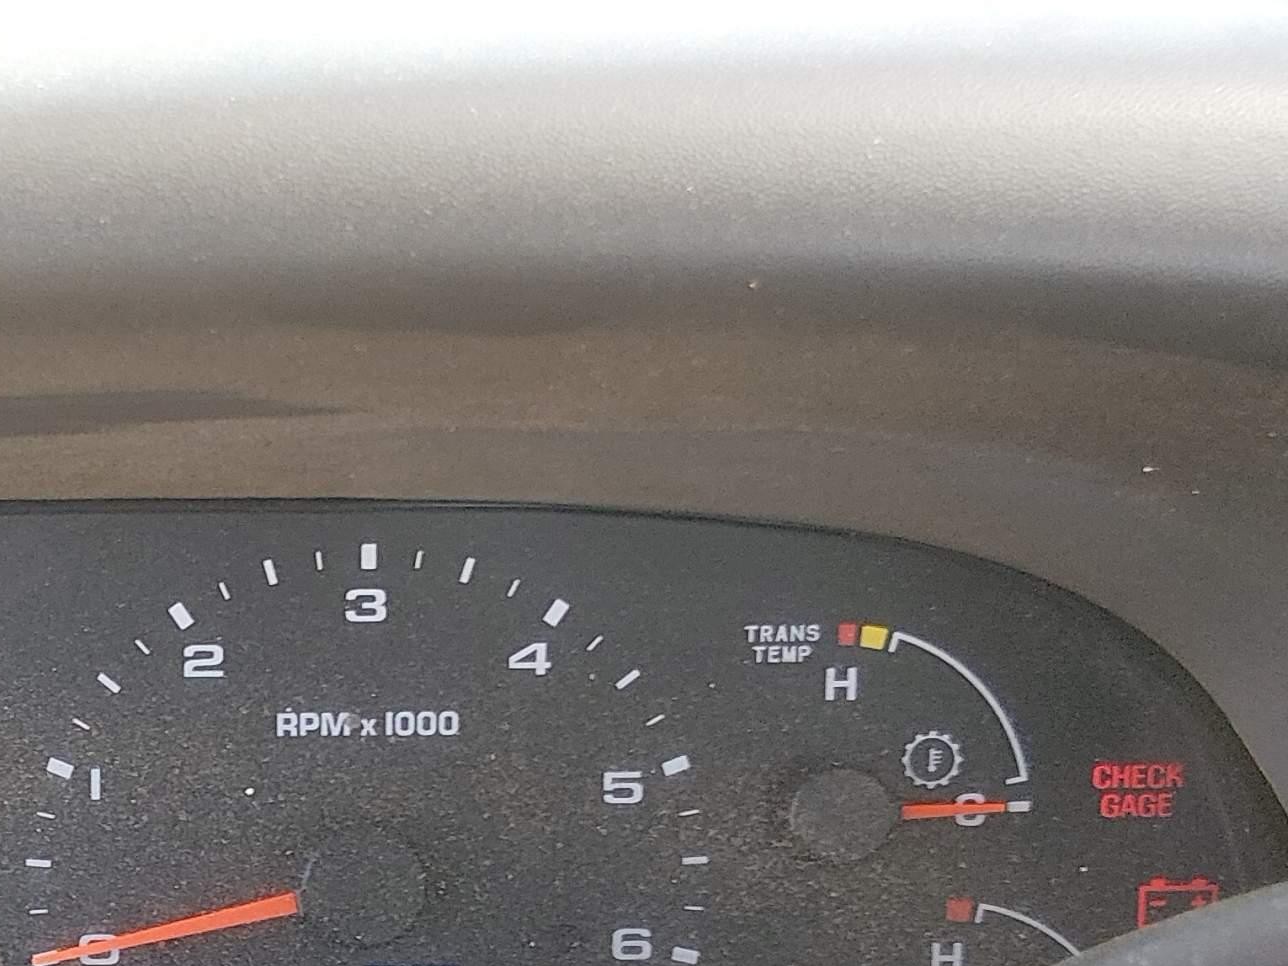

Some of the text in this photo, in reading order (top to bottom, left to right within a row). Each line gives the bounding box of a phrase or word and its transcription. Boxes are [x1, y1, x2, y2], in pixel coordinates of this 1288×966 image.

[345, 588, 387, 622] 3
[744, 624, 821, 643] TRANS
[183, 644, 224, 678] 2
[508, 642, 552, 676] 4
[752, 645, 813, 663] TEMP
[825, 667, 858, 701] H
[276, 711, 460, 736] RPM x 1000
[90, 768, 101, 801] 1
[603, 771, 644, 804] 5
[1092, 763, 1184, 789] CHECK
[1100, 793, 1174, 818] GAGE
[79, 934, 120, 966] 0
[611, 928, 653, 961] 6
